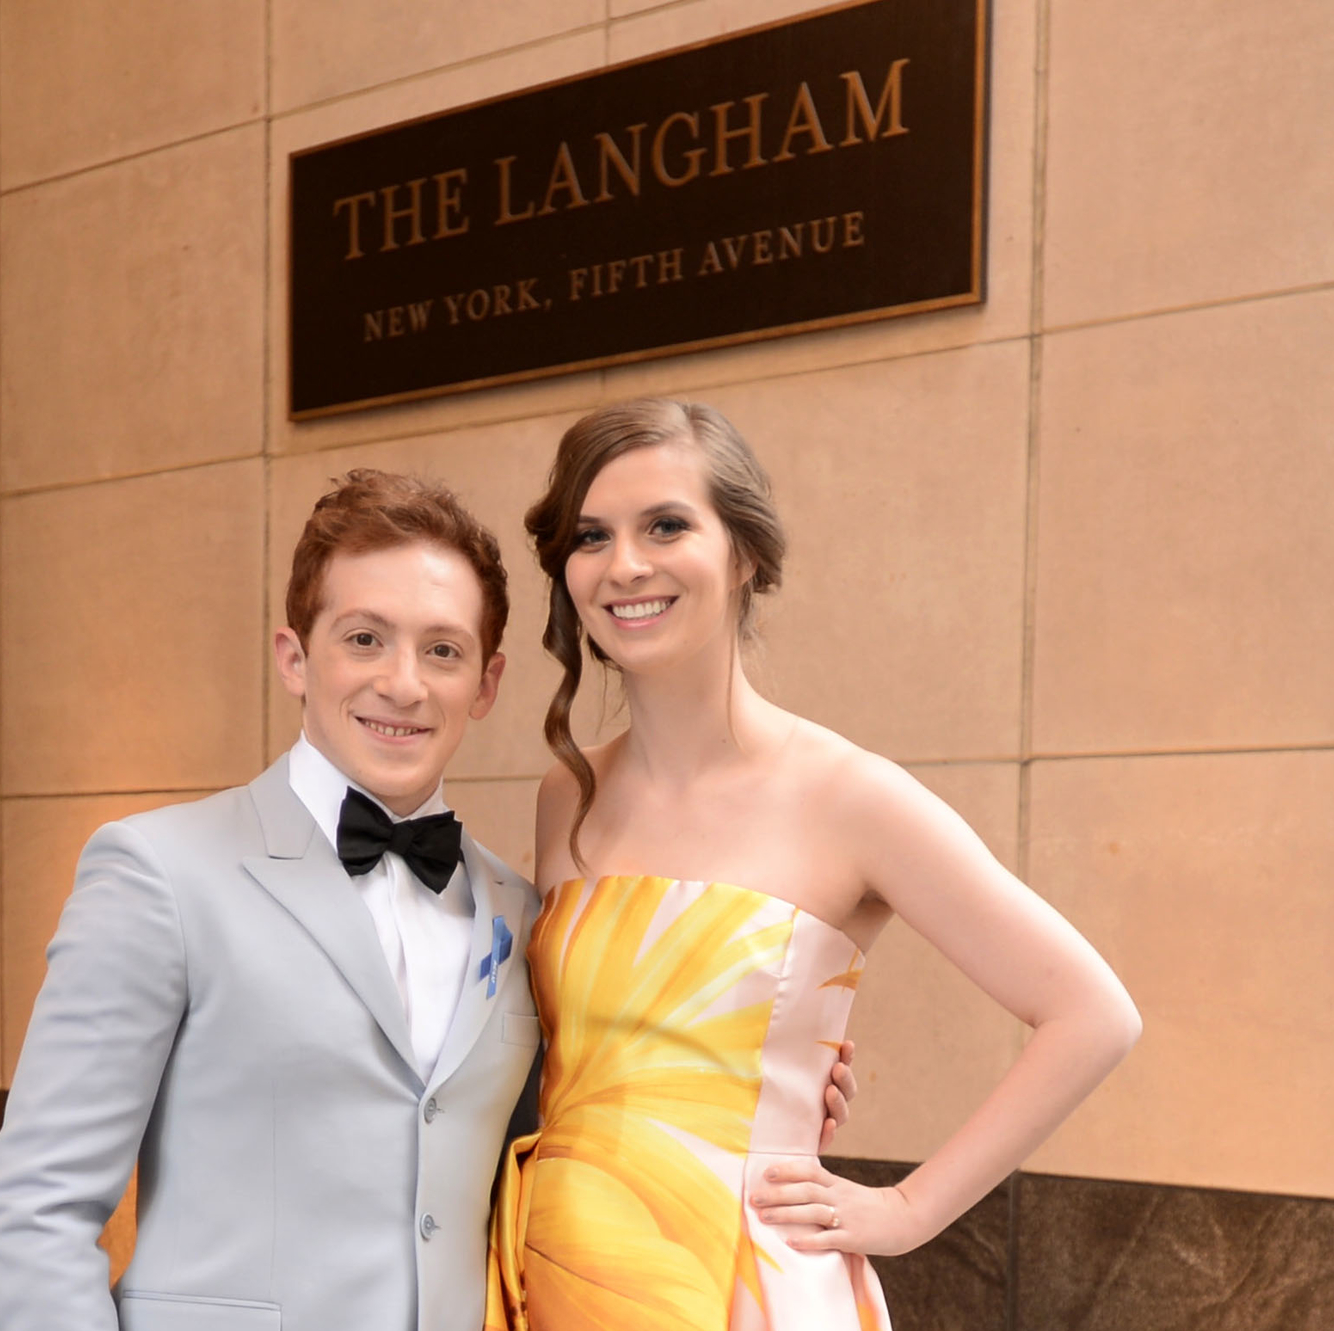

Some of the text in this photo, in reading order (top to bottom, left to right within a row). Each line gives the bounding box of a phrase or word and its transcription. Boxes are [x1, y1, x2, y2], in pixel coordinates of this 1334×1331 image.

[333, 58, 911, 262] THE LANGHAM
[364, 211, 866, 343] NEW YORK, FIFTH AVENUE
